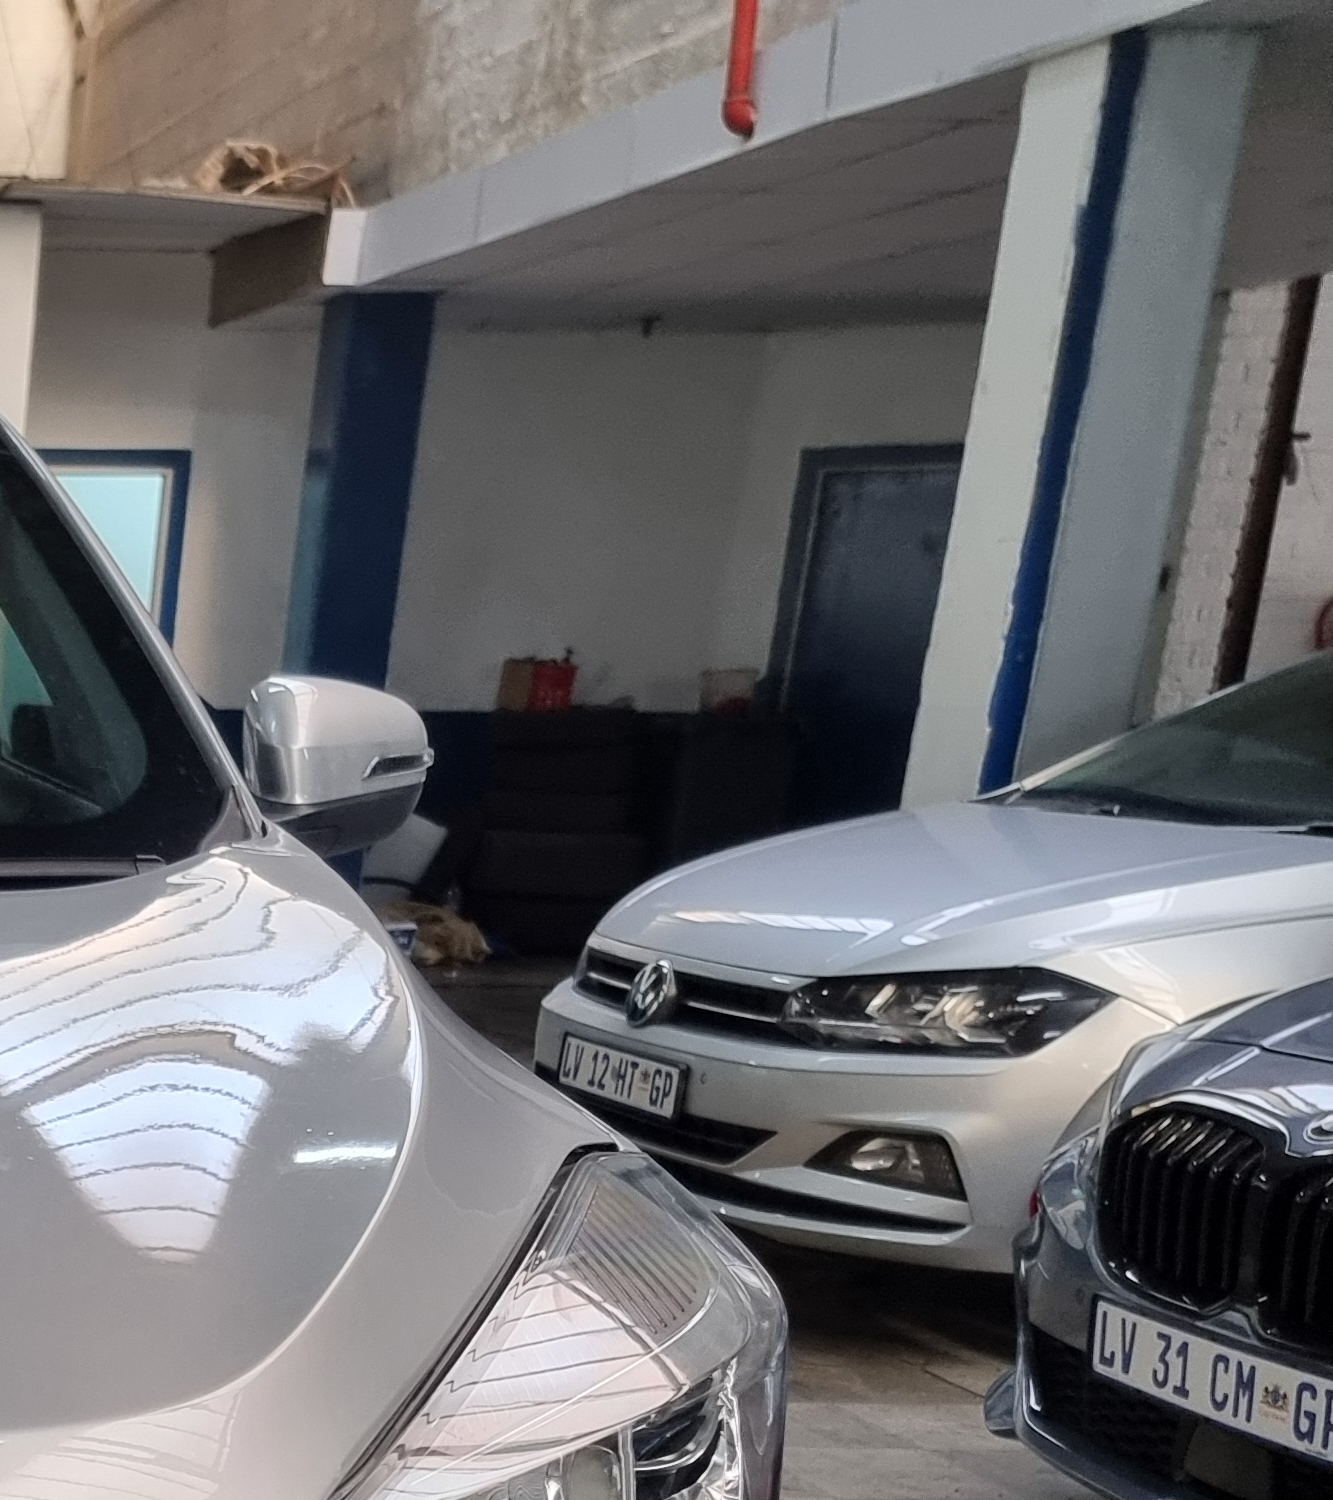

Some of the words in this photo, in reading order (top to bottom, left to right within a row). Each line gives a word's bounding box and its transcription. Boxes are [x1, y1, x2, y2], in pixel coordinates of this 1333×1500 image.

[562, 1042, 585, 1081] LV
[587, 1049, 611, 1091] 12
[614, 1057, 640, 1100] HT
[648, 1068, 674, 1110] GP
[1098, 1309, 1137, 1376] LV
[1151, 1330, 1190, 1401] 31
[1209, 1353, 1257, 1424] CM
